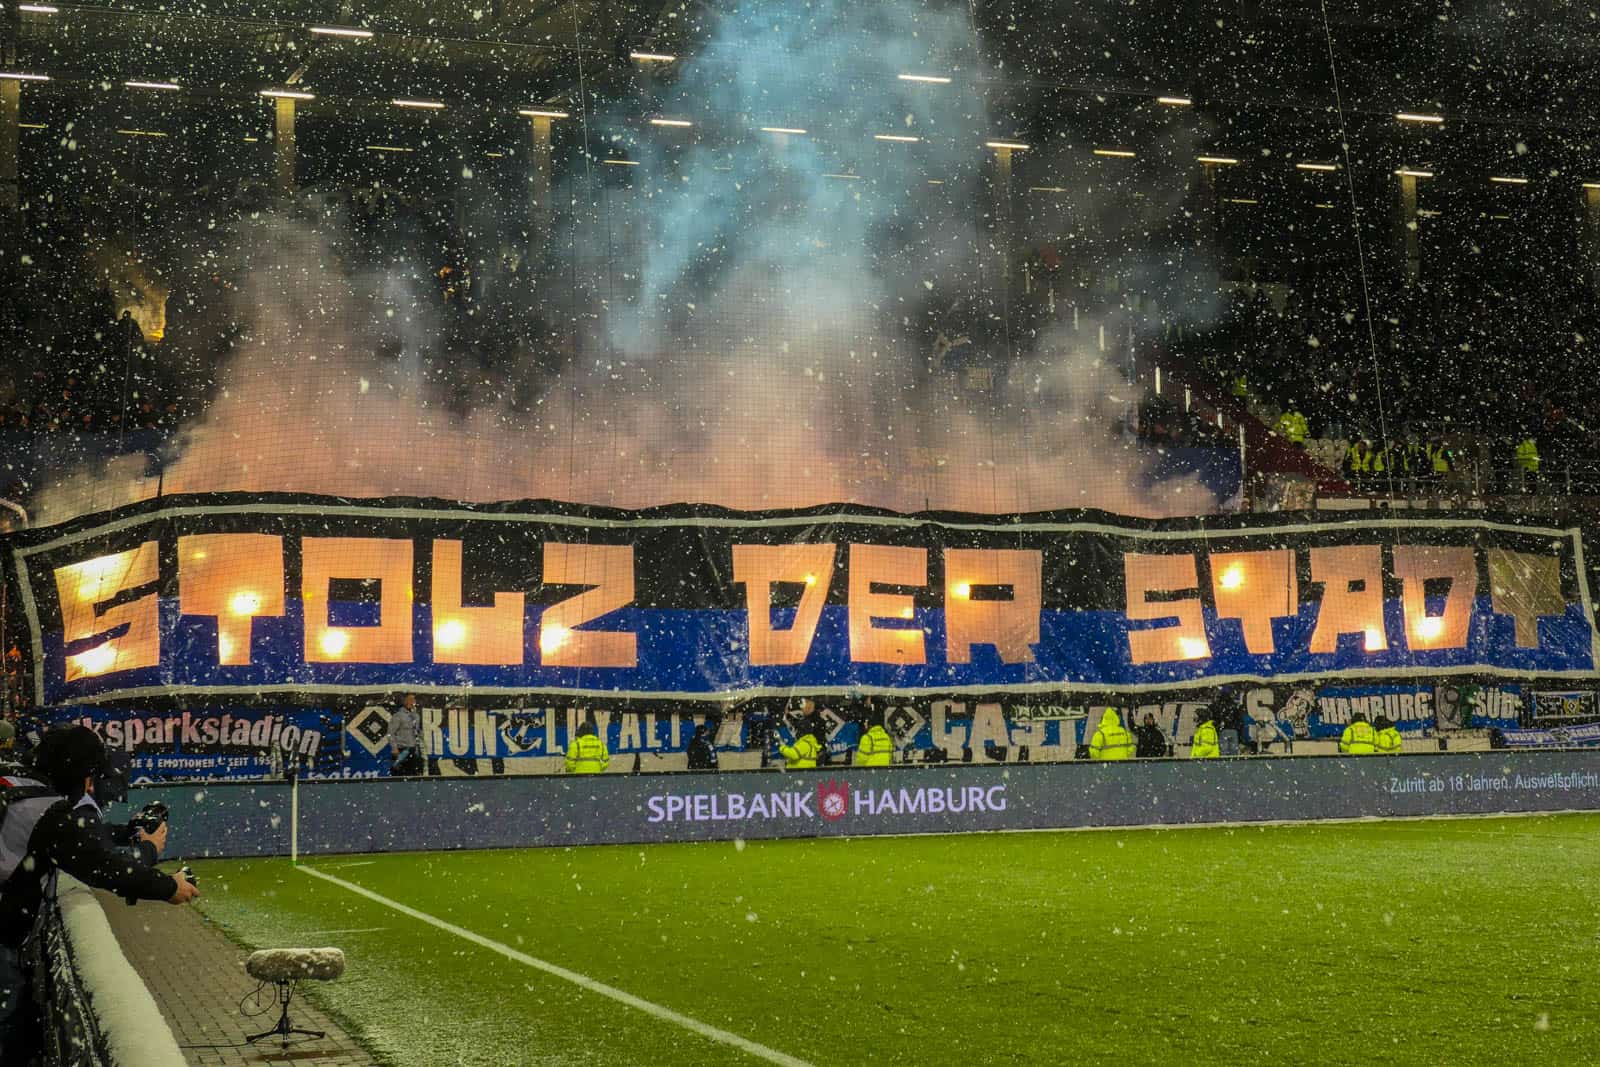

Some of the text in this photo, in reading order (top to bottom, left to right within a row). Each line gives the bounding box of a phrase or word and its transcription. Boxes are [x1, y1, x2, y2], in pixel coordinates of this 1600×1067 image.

[54, 533, 1566, 681] STOLZ DER STADT
[1320, 691, 1428, 724] HAMBURG
[228, 757, 249, 767] SEIT
[253, 756, 274, 766] 195
[1390, 777, 1427, 793] Zutritt
[1429, 777, 1445, 792] ab
[1449, 777, 1464, 791] 18
[1467, 774, 1511, 792] Jahren.
[647, 785, 1007, 823] SPIELBANK HAMBURG
